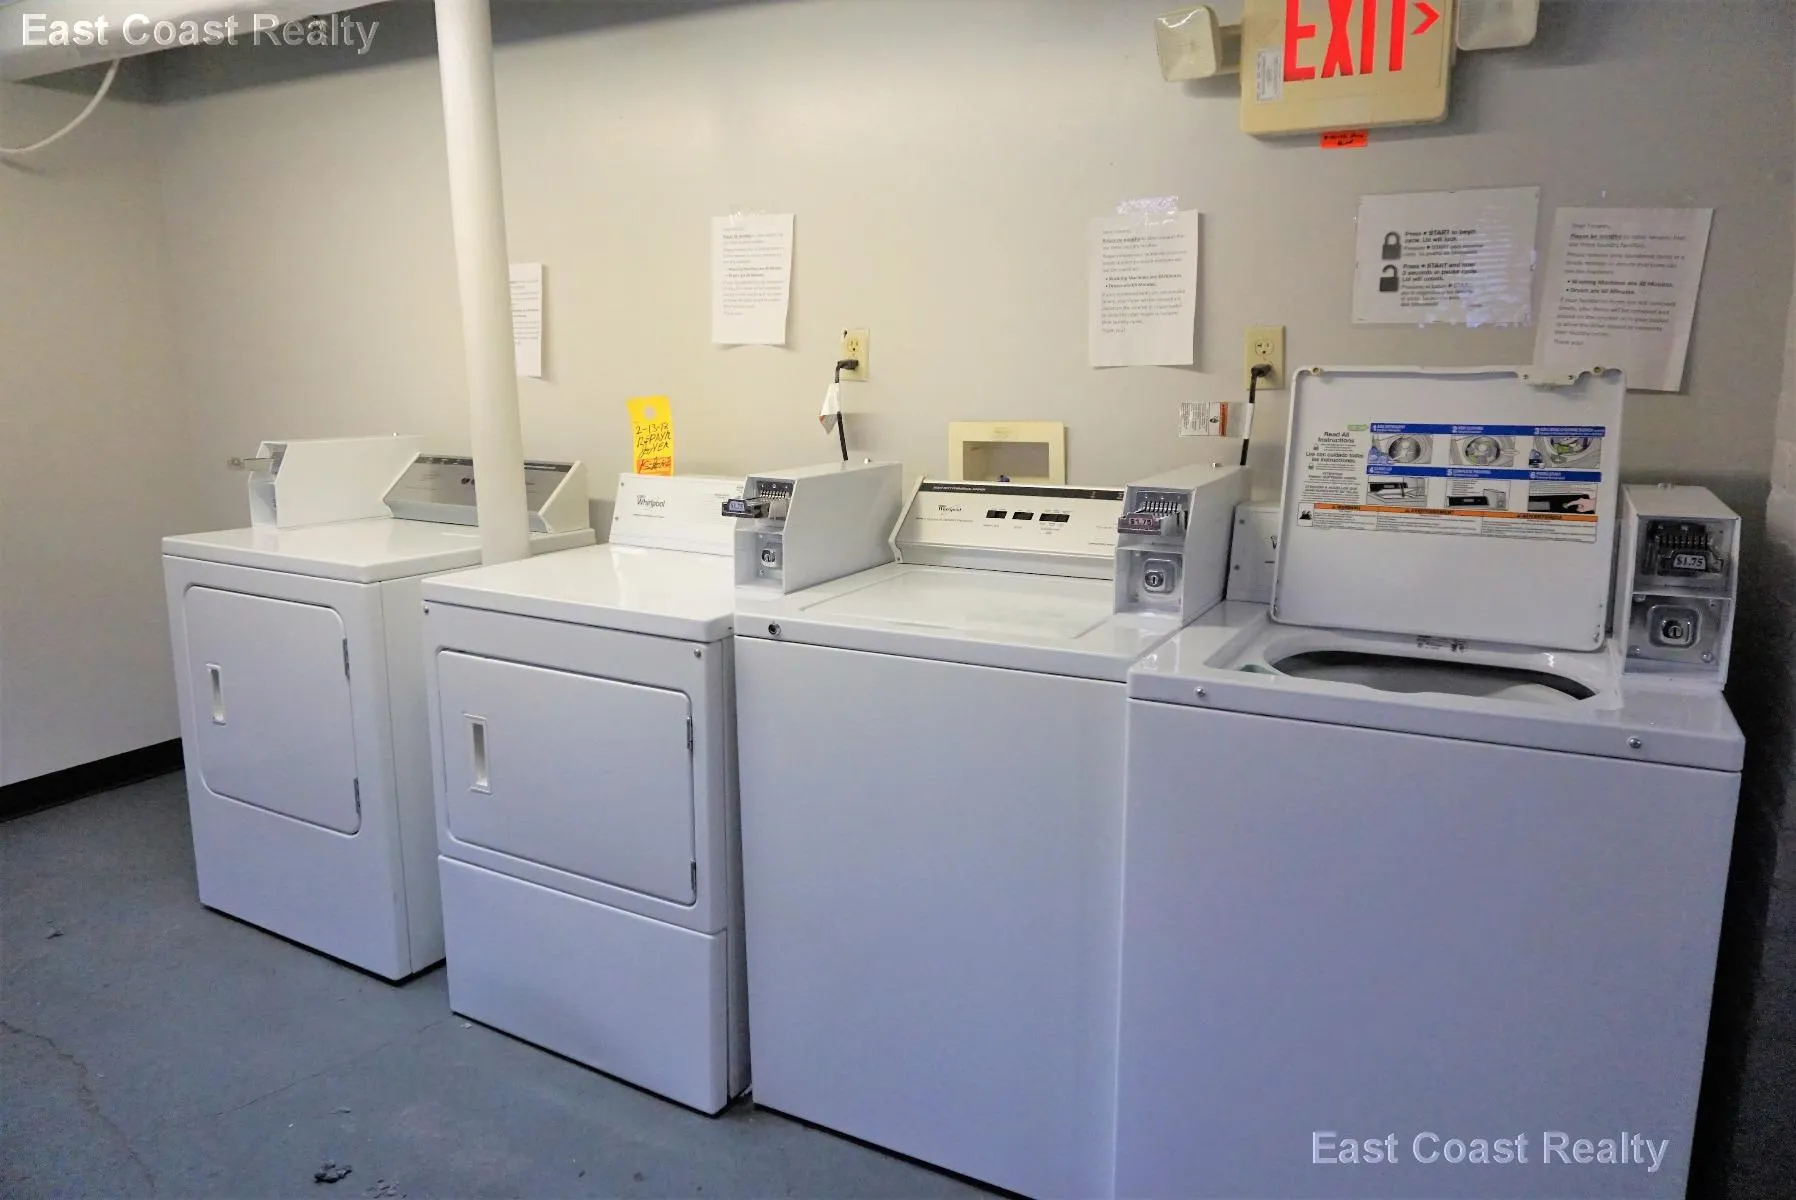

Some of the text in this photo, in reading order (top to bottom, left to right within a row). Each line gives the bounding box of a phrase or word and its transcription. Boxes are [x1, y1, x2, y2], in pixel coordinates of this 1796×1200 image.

[1283, 0, 1407, 82] EXIT
[637, 498, 666, 508] Whirlpool
[1677, 556, 1704, 567] $1.75
